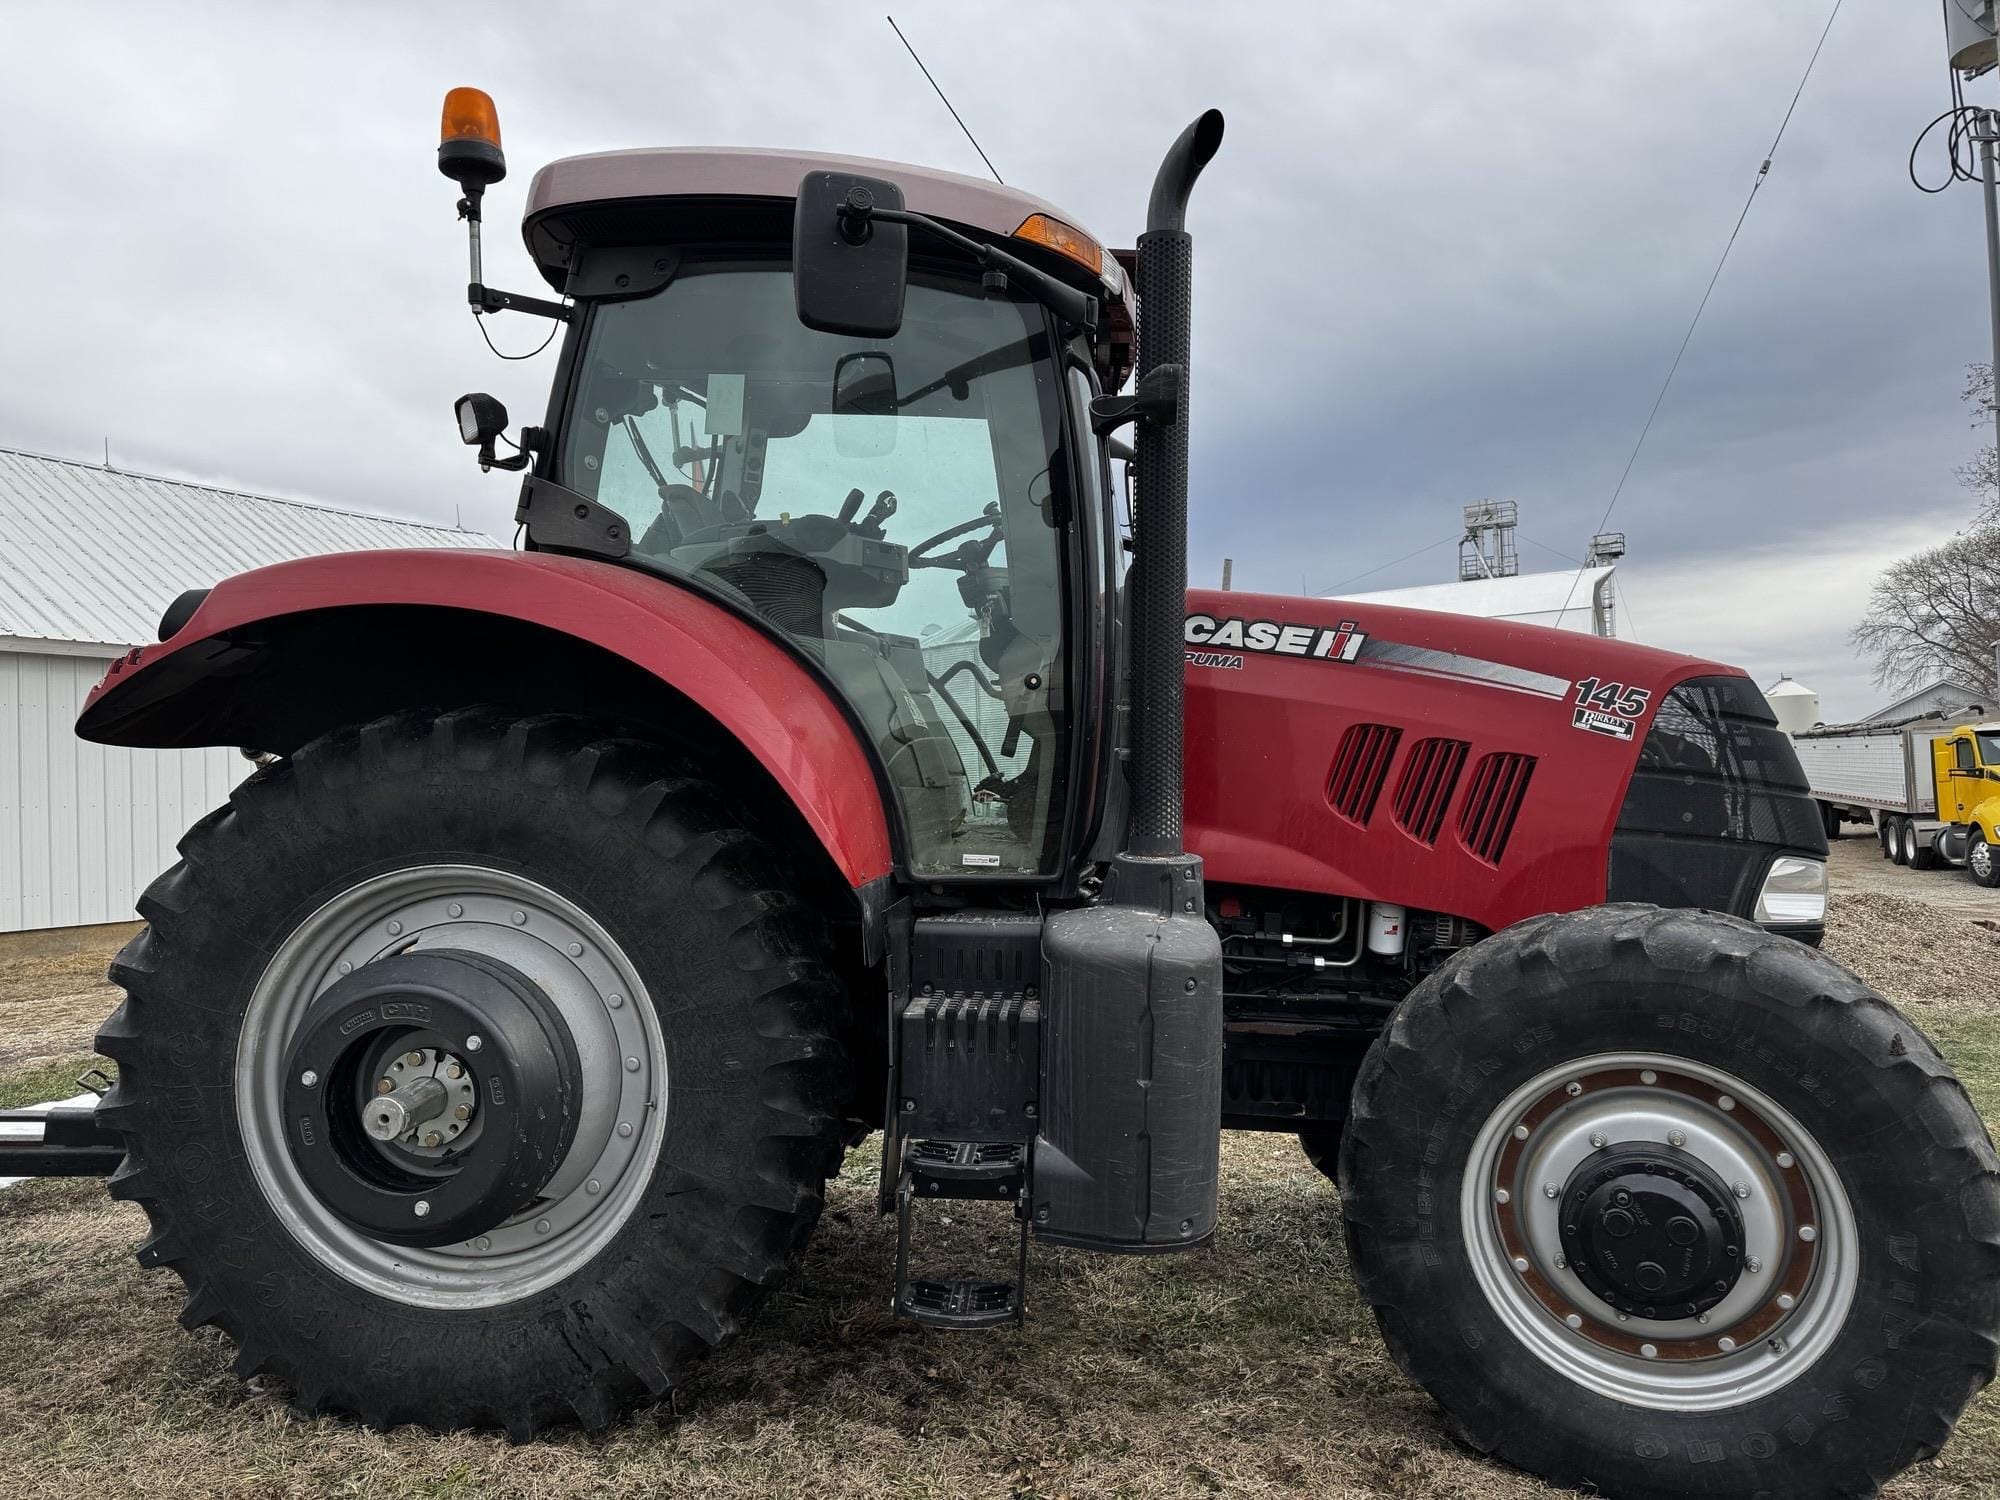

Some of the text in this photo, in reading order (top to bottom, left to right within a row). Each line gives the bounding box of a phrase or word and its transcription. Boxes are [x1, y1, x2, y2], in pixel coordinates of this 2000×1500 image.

[1184, 615, 1315, 655] CASE
[1184, 651, 1244, 670] PUMA
[1575, 676, 1652, 718] 145
[1581, 711, 1628, 729] BIRKEY'S
[1417, 1057, 1504, 1268] PERFORMER
